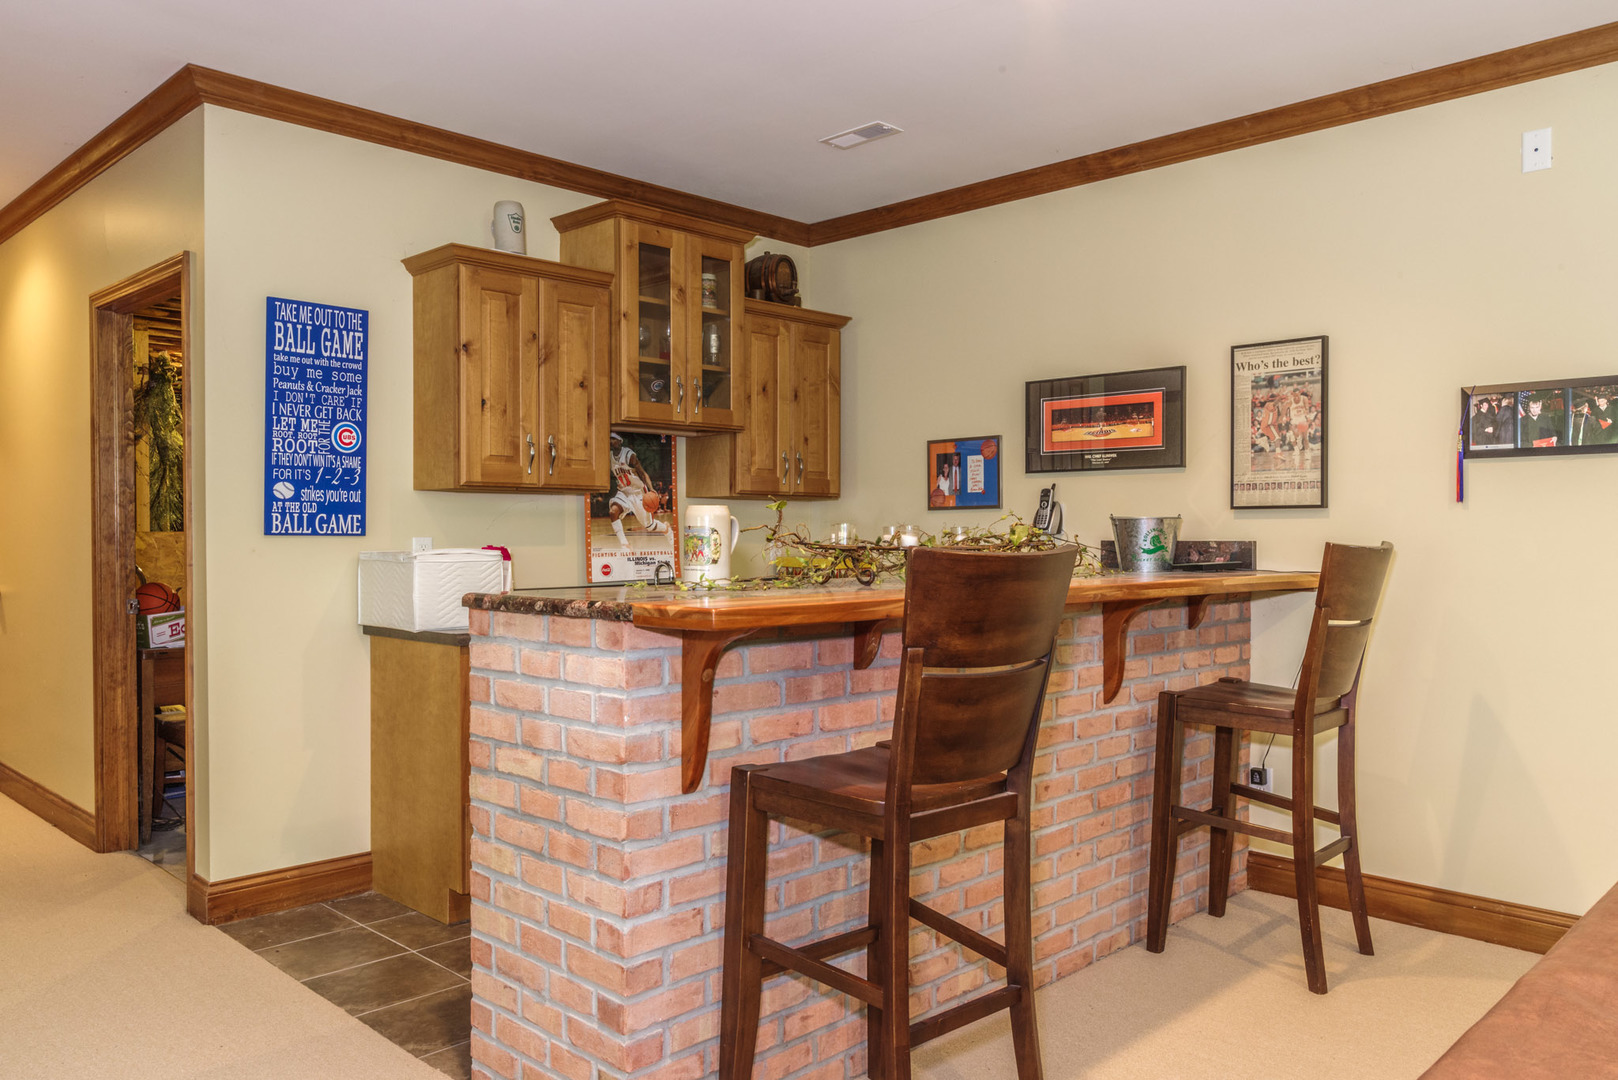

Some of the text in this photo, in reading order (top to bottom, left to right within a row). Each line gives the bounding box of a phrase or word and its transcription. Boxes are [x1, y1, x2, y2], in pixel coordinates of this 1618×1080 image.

[275, 301, 363, 331] TAKE ME OUT TO THE
[274, 321, 363, 360] BALL GAME
[273, 353, 362, 370] take me out with the crowd
[1235, 354, 1321, 372] Who's the best?
[273, 361, 362, 383] buy me some
[273, 377, 362, 398] Peanuts & Cracker Jack
[273, 390, 362, 408] I DON'T CARE IF
[279, 403, 311, 418] NEVER
[314, 405, 333, 419] GET
[336, 407, 362, 421] BACK
[272, 416, 318, 433] LET ME
[298, 431, 318, 440] ROOT
[317, 420, 331, 455] FOR THE
[271, 438, 318, 454] ROOT
[271, 452, 277, 465] IF
[278, 452, 294, 466] THEY
[312, 454, 325, 467] WIN
[335, 455, 341, 468] A
[341, 455, 361, 469] SHAME
[272, 468, 292, 480] FOR
[294, 468, 311, 481] IT'S
[300, 485, 361, 505] strikes you're out
[272, 501, 317, 513] AT THE OLD
[271, 512, 362, 534] BALL GAME
